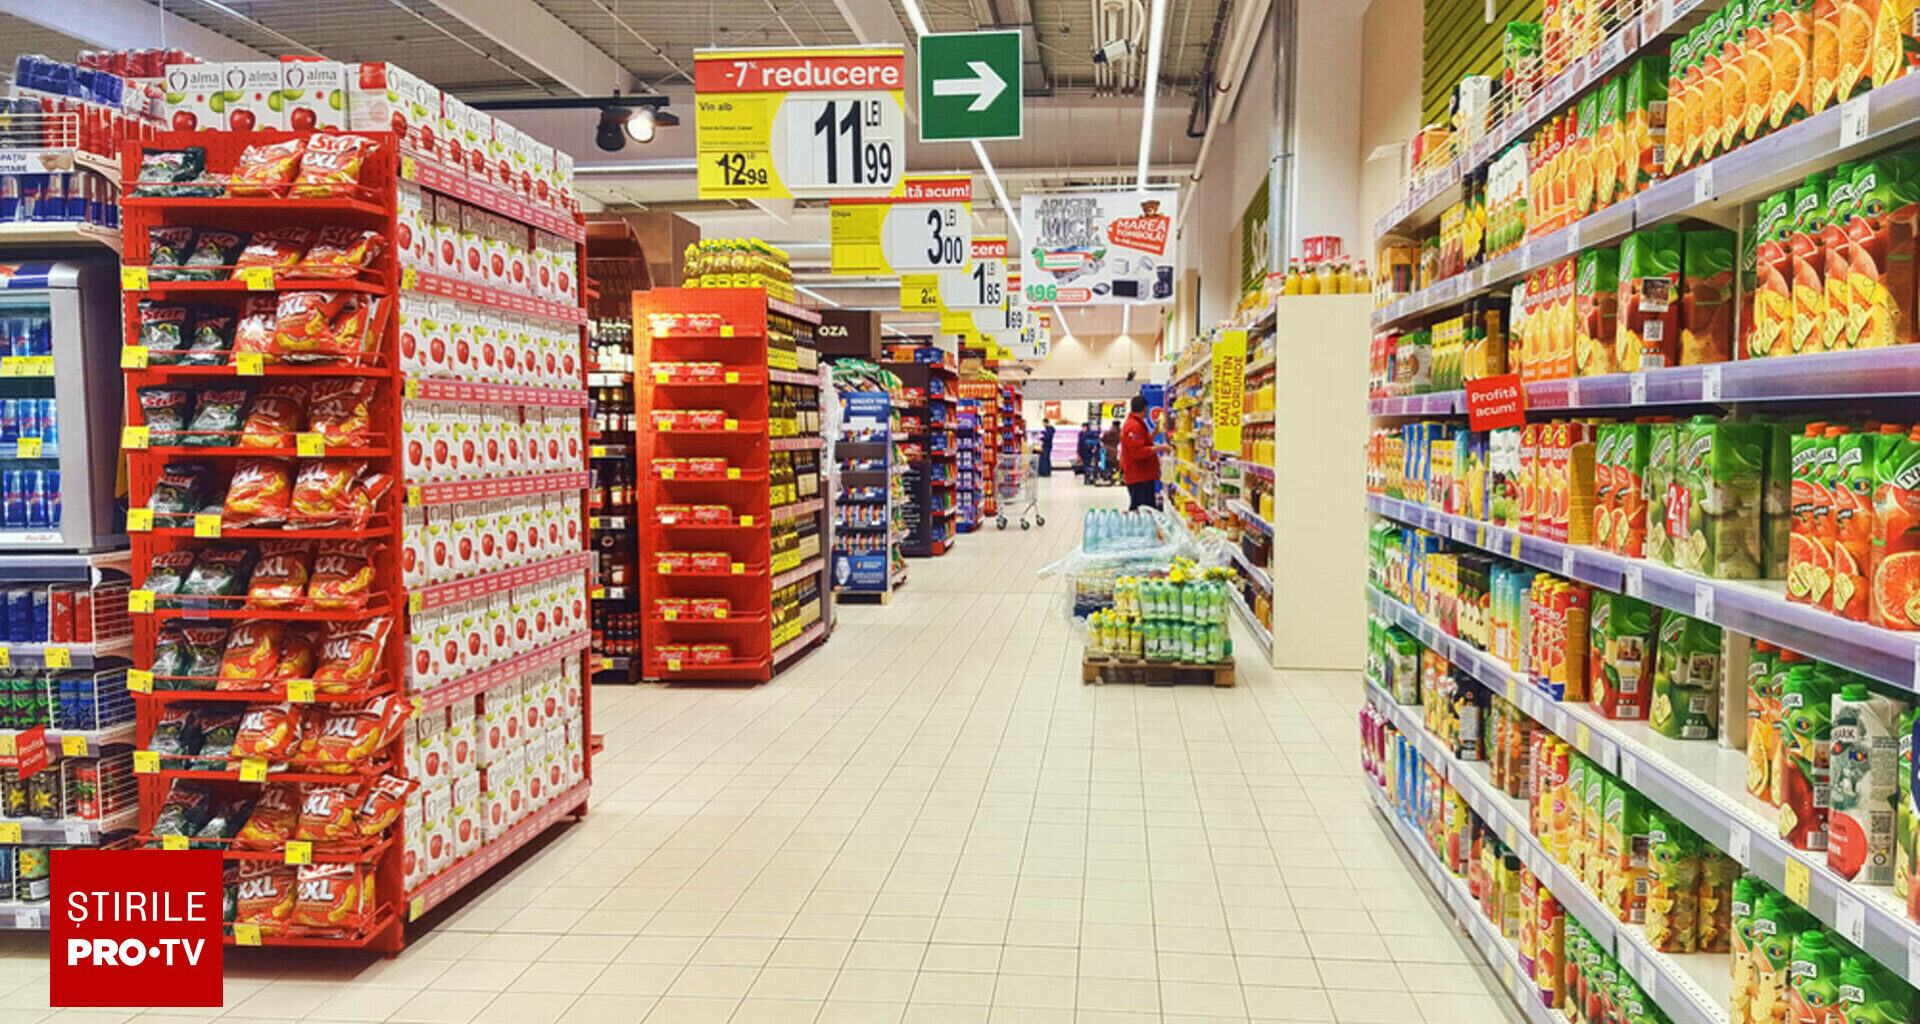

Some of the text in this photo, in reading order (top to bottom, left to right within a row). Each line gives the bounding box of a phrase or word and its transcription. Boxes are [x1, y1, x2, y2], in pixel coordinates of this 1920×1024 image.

[190, 69, 219, 84] alma
[248, 68, 278, 82] alma
[306, 66, 337, 80] alma
[762, 60, 899, 87] reducere
[700, 101, 733, 112] Vin alb
[865, 100, 882, 127] LEI
[814, 100, 863, 184] 11
[717, 153, 747, 186] 12
[865, 141, 893, 184] 99
[924, 184, 970, 198] acum!
[945, 208, 956, 227] LEI
[1116, 220, 1166, 232] MAREA
[926, 208, 944, 265] 3
[944, 236, 963, 264] 00
[972, 244, 1005, 255] cere
[973, 262, 1001, 305] 1 85
[1026, 284, 1057, 301] 196
[1220, 355, 1233, 426] MAI IEFTIN
[1230, 355, 1244, 428] CA ORIUNDE
[1471, 386, 1517, 404] Profită
[1475, 402, 1517, 418] acum!
